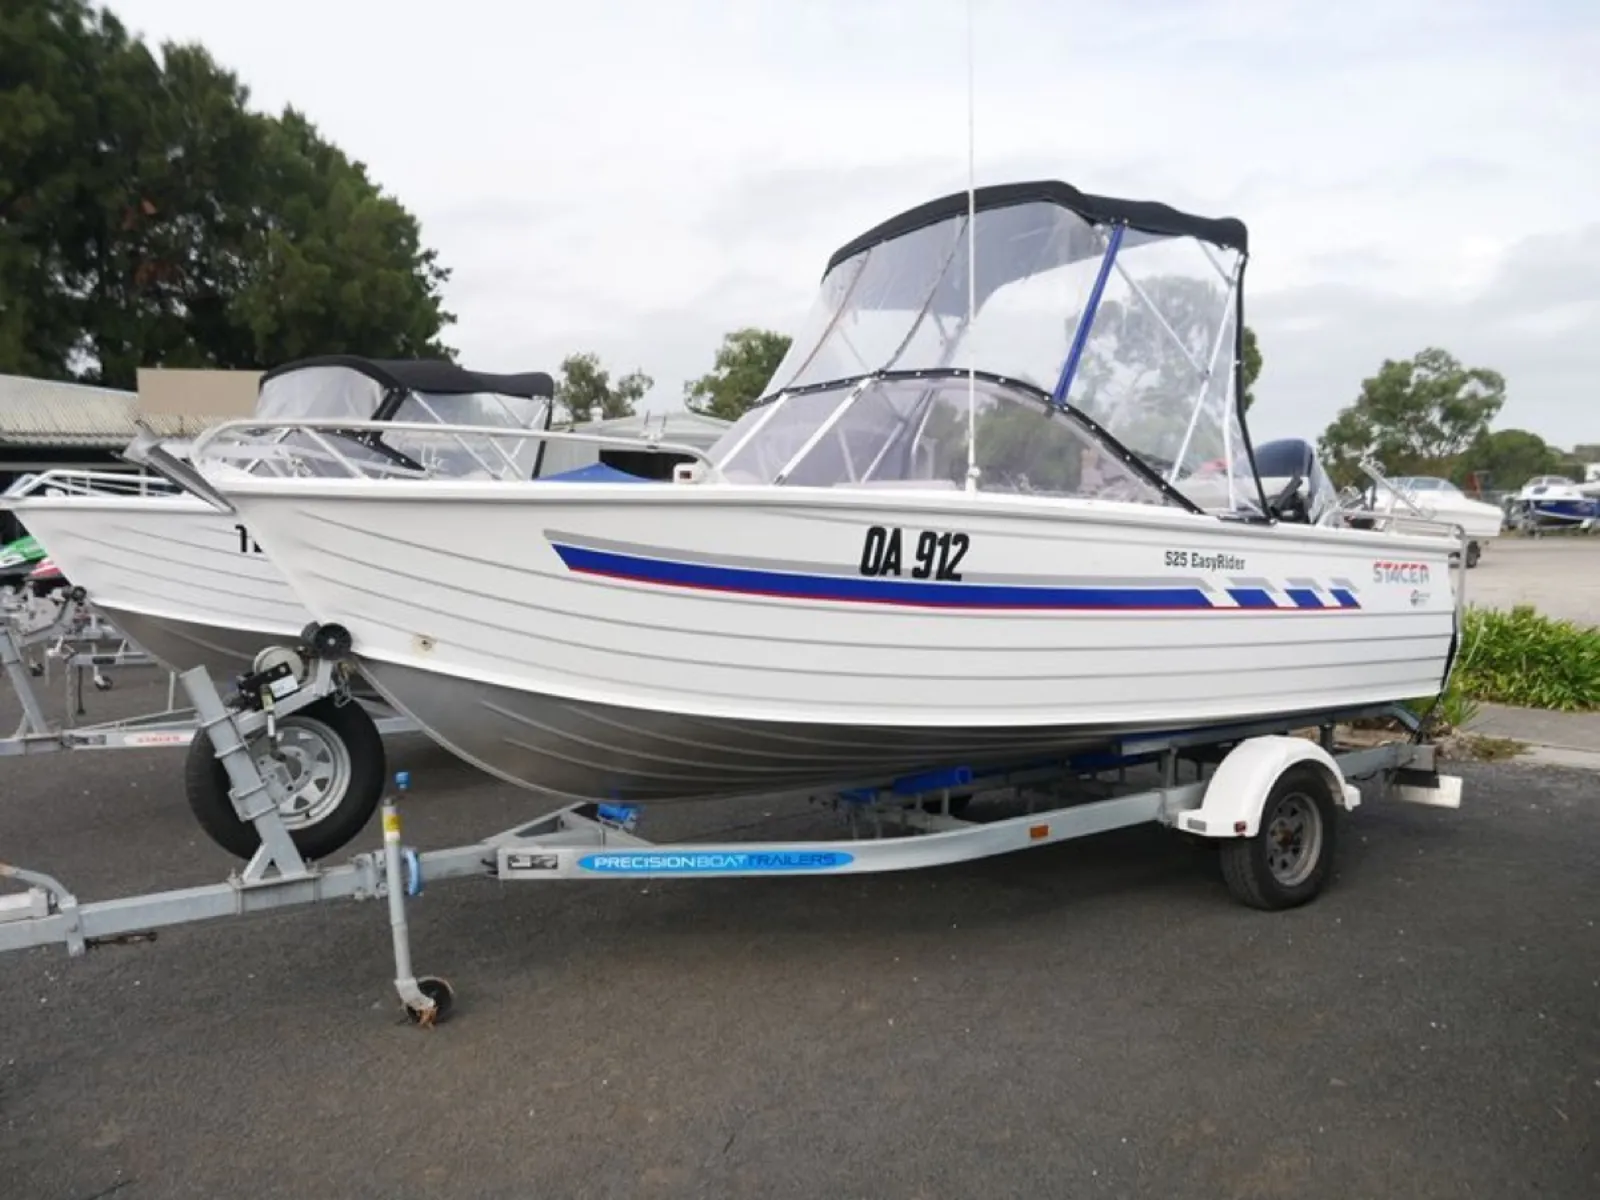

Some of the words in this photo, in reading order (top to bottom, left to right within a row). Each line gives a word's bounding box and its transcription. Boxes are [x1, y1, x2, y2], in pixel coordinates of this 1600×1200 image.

[860, 525, 902, 577] OA
[912, 531, 970, 582] 912
[1191, 552, 1246, 572] EasyRider
[1373, 561, 1430, 584] STACER
